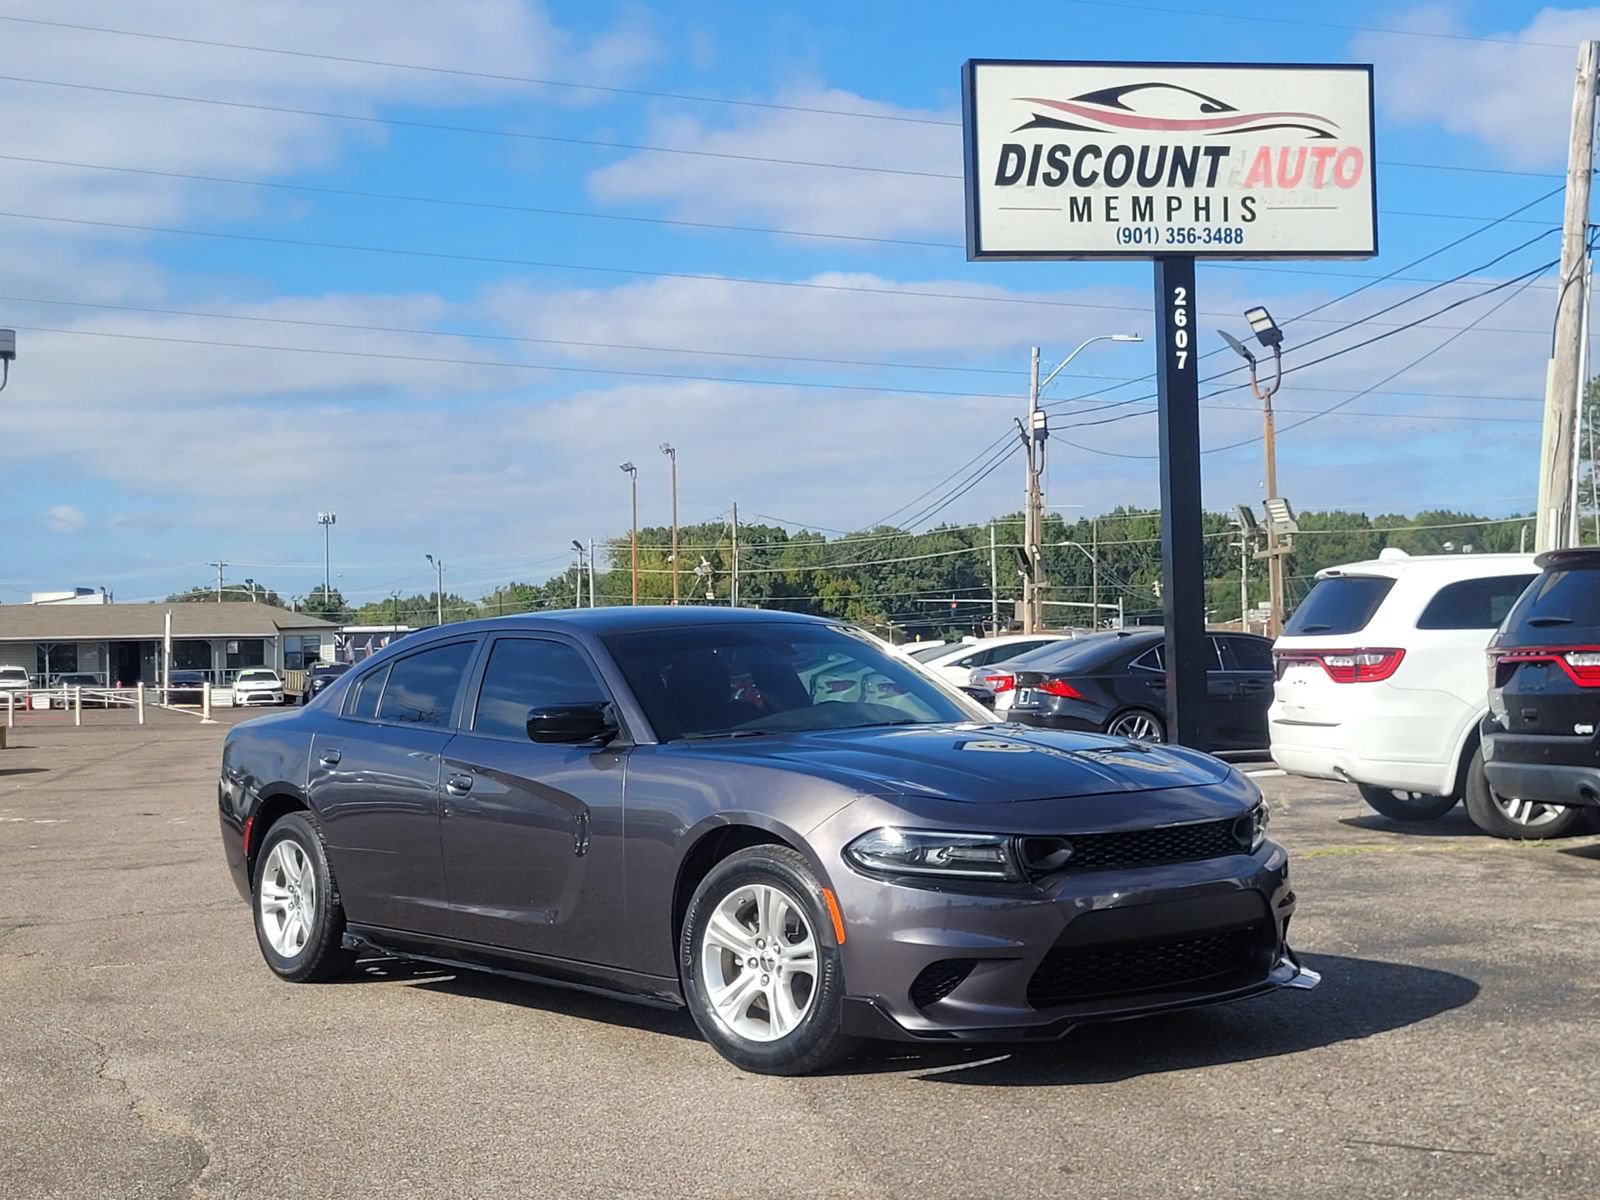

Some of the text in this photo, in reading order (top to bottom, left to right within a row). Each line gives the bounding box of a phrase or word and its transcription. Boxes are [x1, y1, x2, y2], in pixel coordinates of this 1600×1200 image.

[994, 144, 1364, 189] DISCOUNT AUTO
[1069, 196, 1257, 223] MEMPHIS
[1116, 226, 1244, 245] (901) 356-3488
[1174, 287, 1188, 370] 2607
